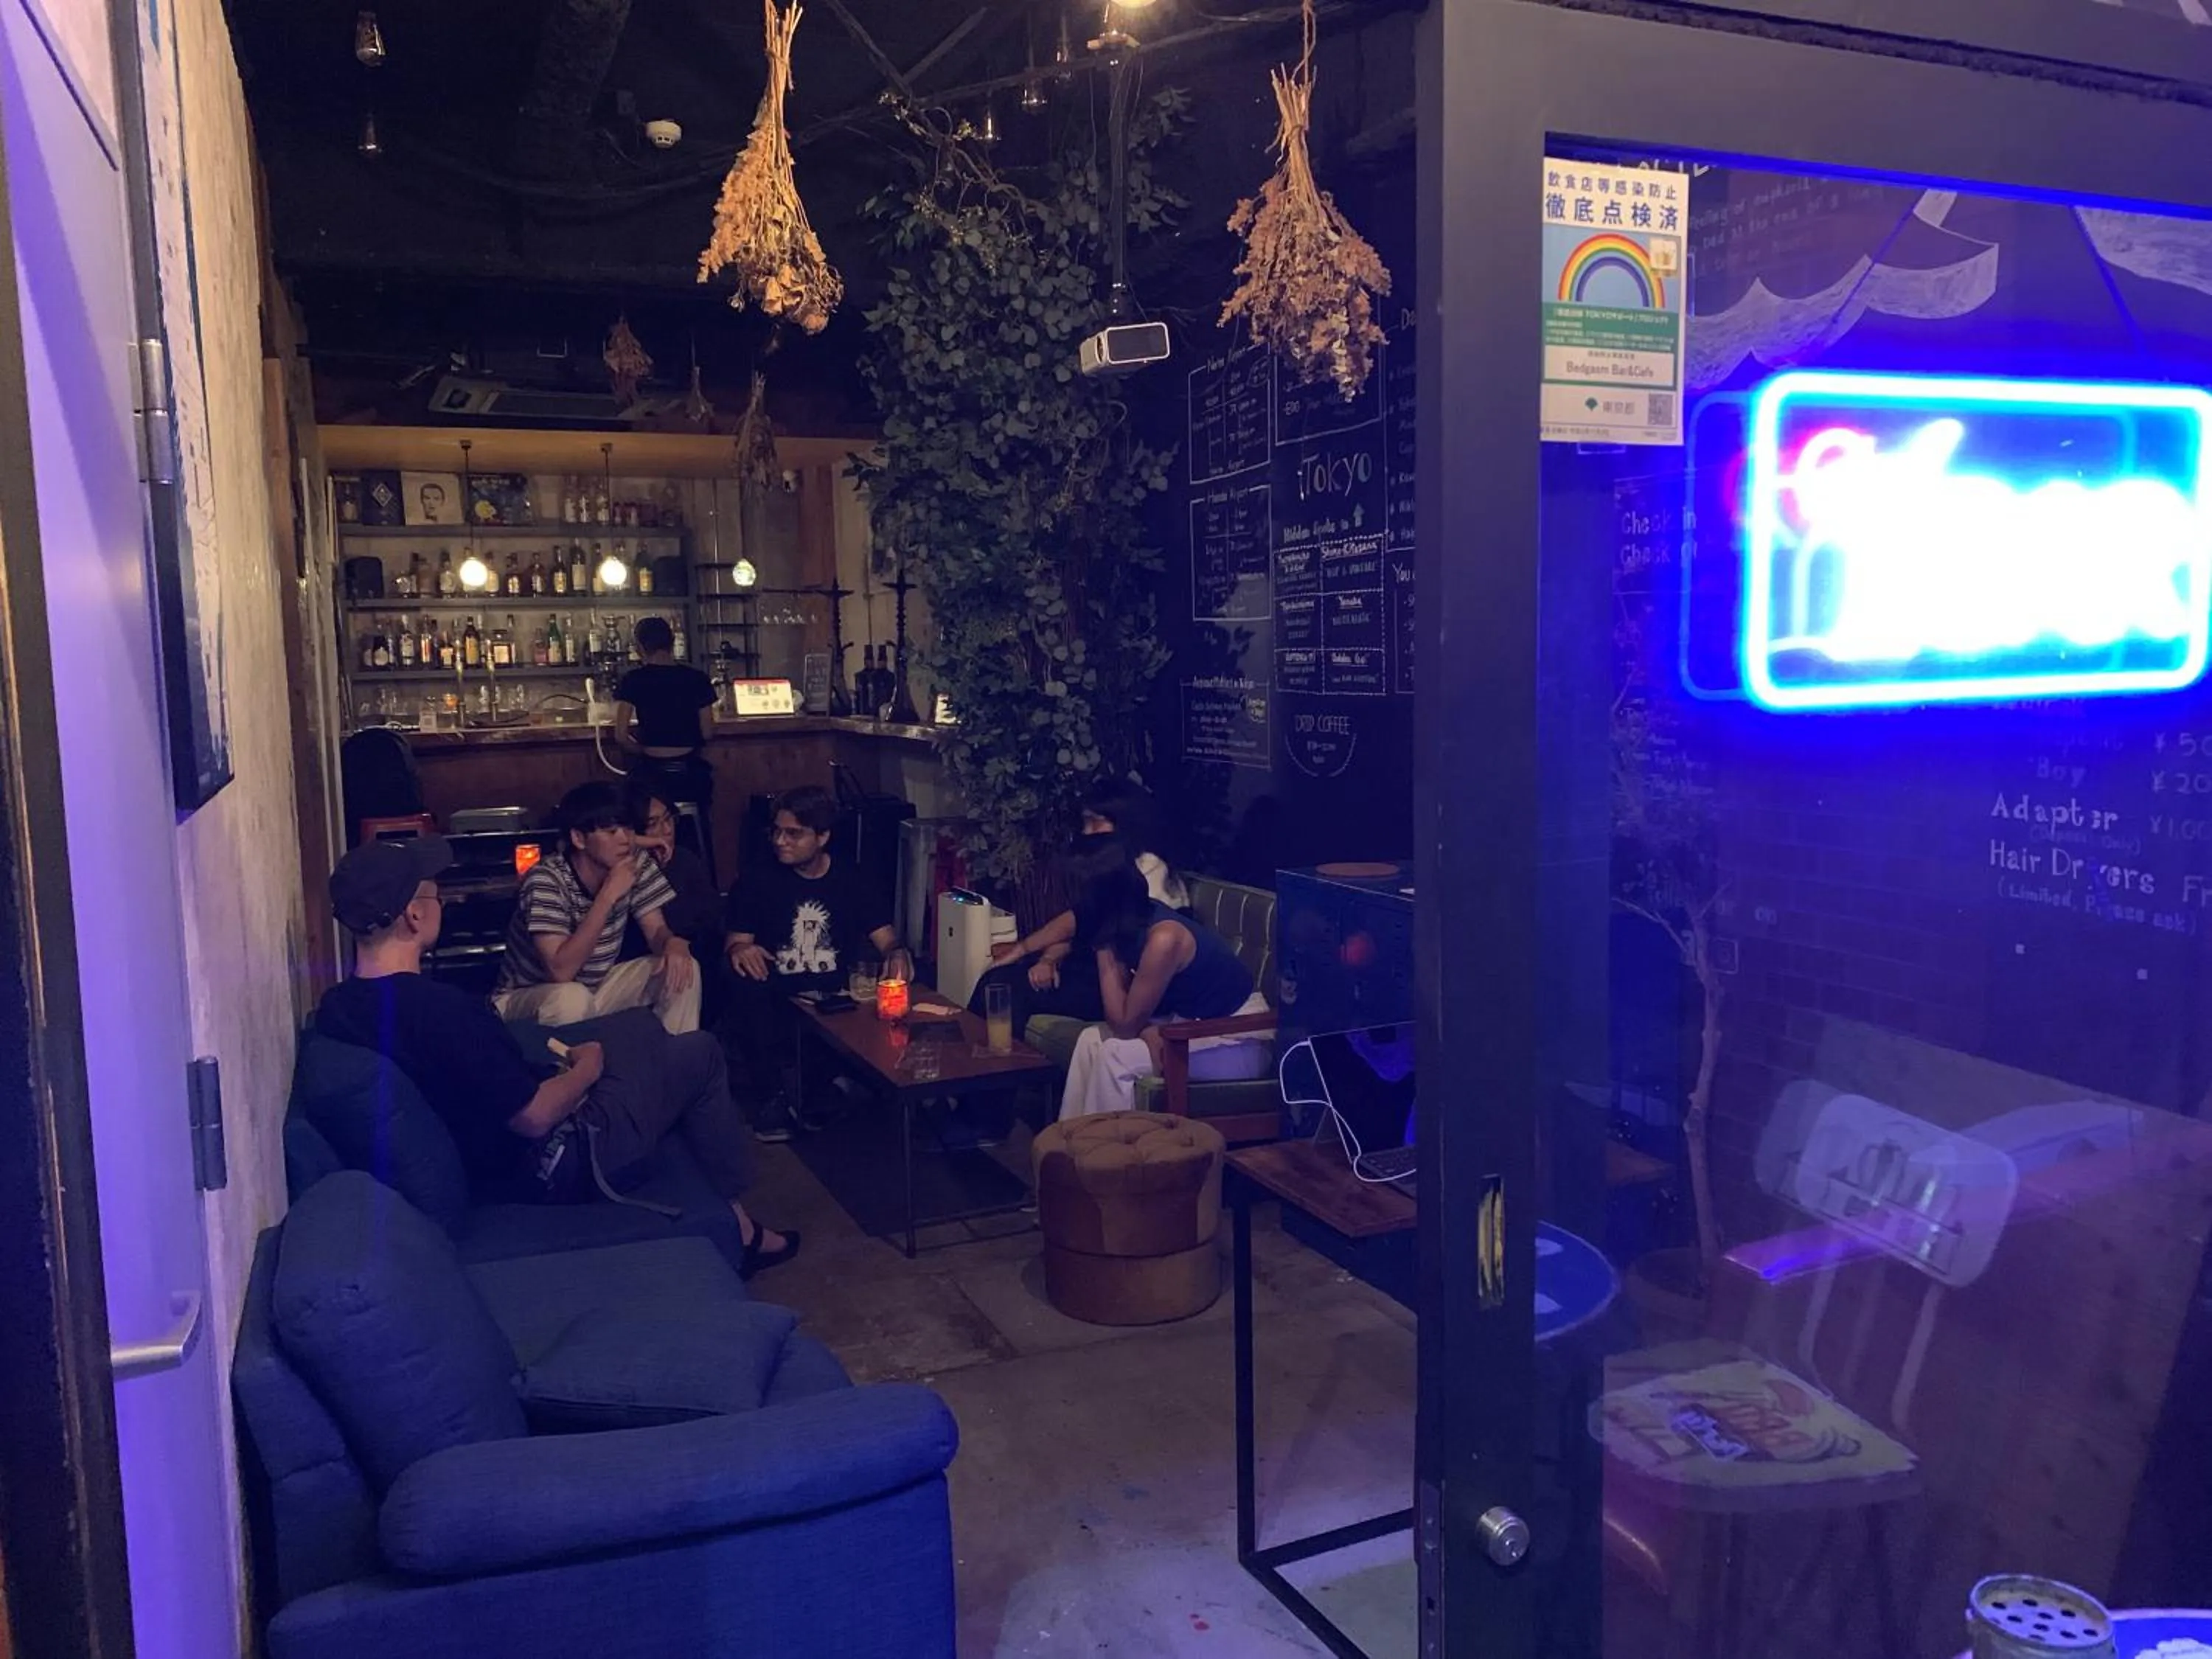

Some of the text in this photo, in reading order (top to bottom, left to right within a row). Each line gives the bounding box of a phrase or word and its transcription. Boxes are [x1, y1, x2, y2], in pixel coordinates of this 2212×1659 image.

[1548, 171, 1677, 201] 飲食店等感染防止
[1545, 193, 1678, 231] 徹底点検済
[1989, 838, 2042, 874] Hair
